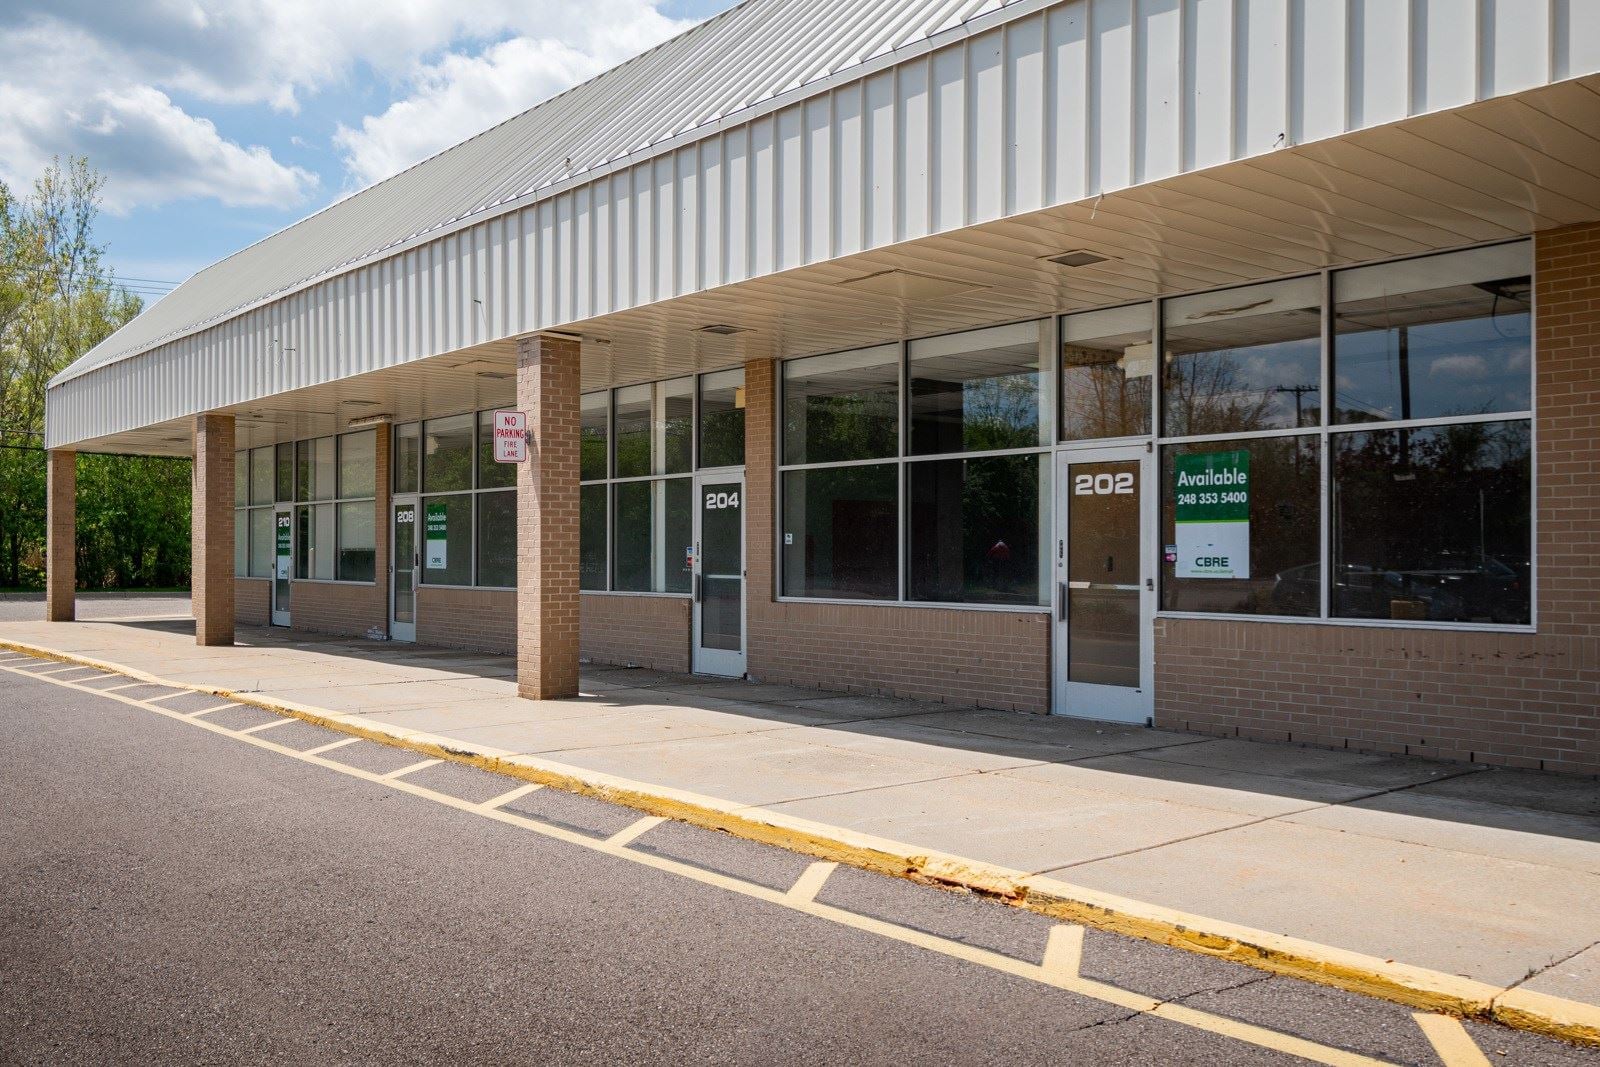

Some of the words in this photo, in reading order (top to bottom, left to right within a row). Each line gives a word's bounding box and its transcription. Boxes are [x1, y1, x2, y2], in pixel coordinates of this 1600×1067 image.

[504, 416, 517, 427] NO
[496, 428, 524, 439] PARKING
[503, 440, 517, 449] FIRE
[503, 450, 518, 458] LANE
[1177, 467, 1248, 487] Available
[1075, 472, 1134, 495] 202
[706, 492, 740, 509] 204
[1178, 493, 1197, 505] 248
[1199, 492, 1218, 504] 353
[1221, 491, 1247, 503] 5400
[278, 516, 290, 527] 210
[397, 510, 414, 523] 208
[1195, 556, 1230, 568] CBRE
